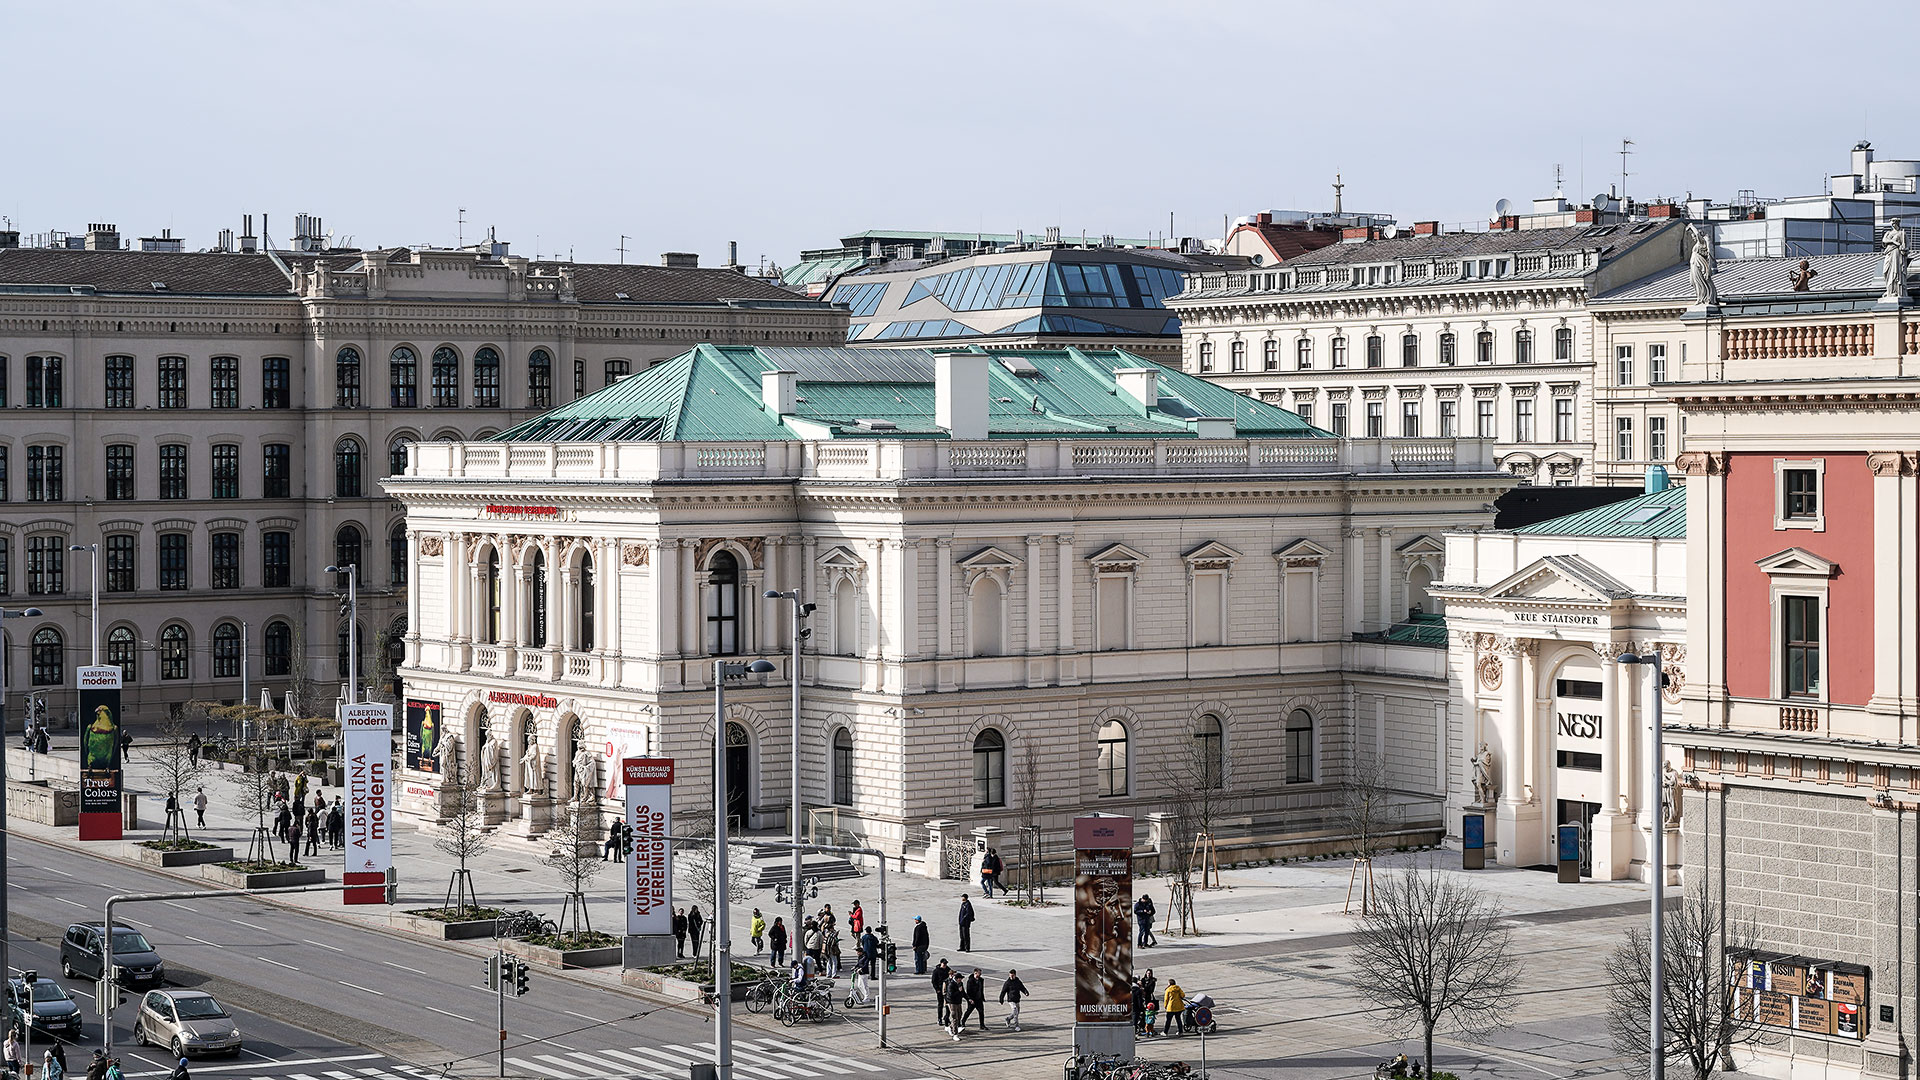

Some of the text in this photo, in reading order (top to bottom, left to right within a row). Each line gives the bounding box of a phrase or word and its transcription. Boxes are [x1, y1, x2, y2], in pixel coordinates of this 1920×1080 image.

[1515, 613, 1598, 625] NEUE STAATSOPER
[82, 677, 117, 685] modern
[488, 691, 557, 709] ALBERTINA modern
[347, 717, 387, 726] modern
[84, 778, 110, 788] True
[84, 788, 117, 797] Colors
[351, 753, 367, 850] ALBERTINA
[367, 762, 385, 840] modern
[633, 805, 650, 915] KÜNSTLERHAUS
[651, 812, 665, 907] VEREINIGUNG
[1771, 964, 1795, 977] KISSIN
[1080, 1004, 1128, 1013] MUSIKVEREIN
